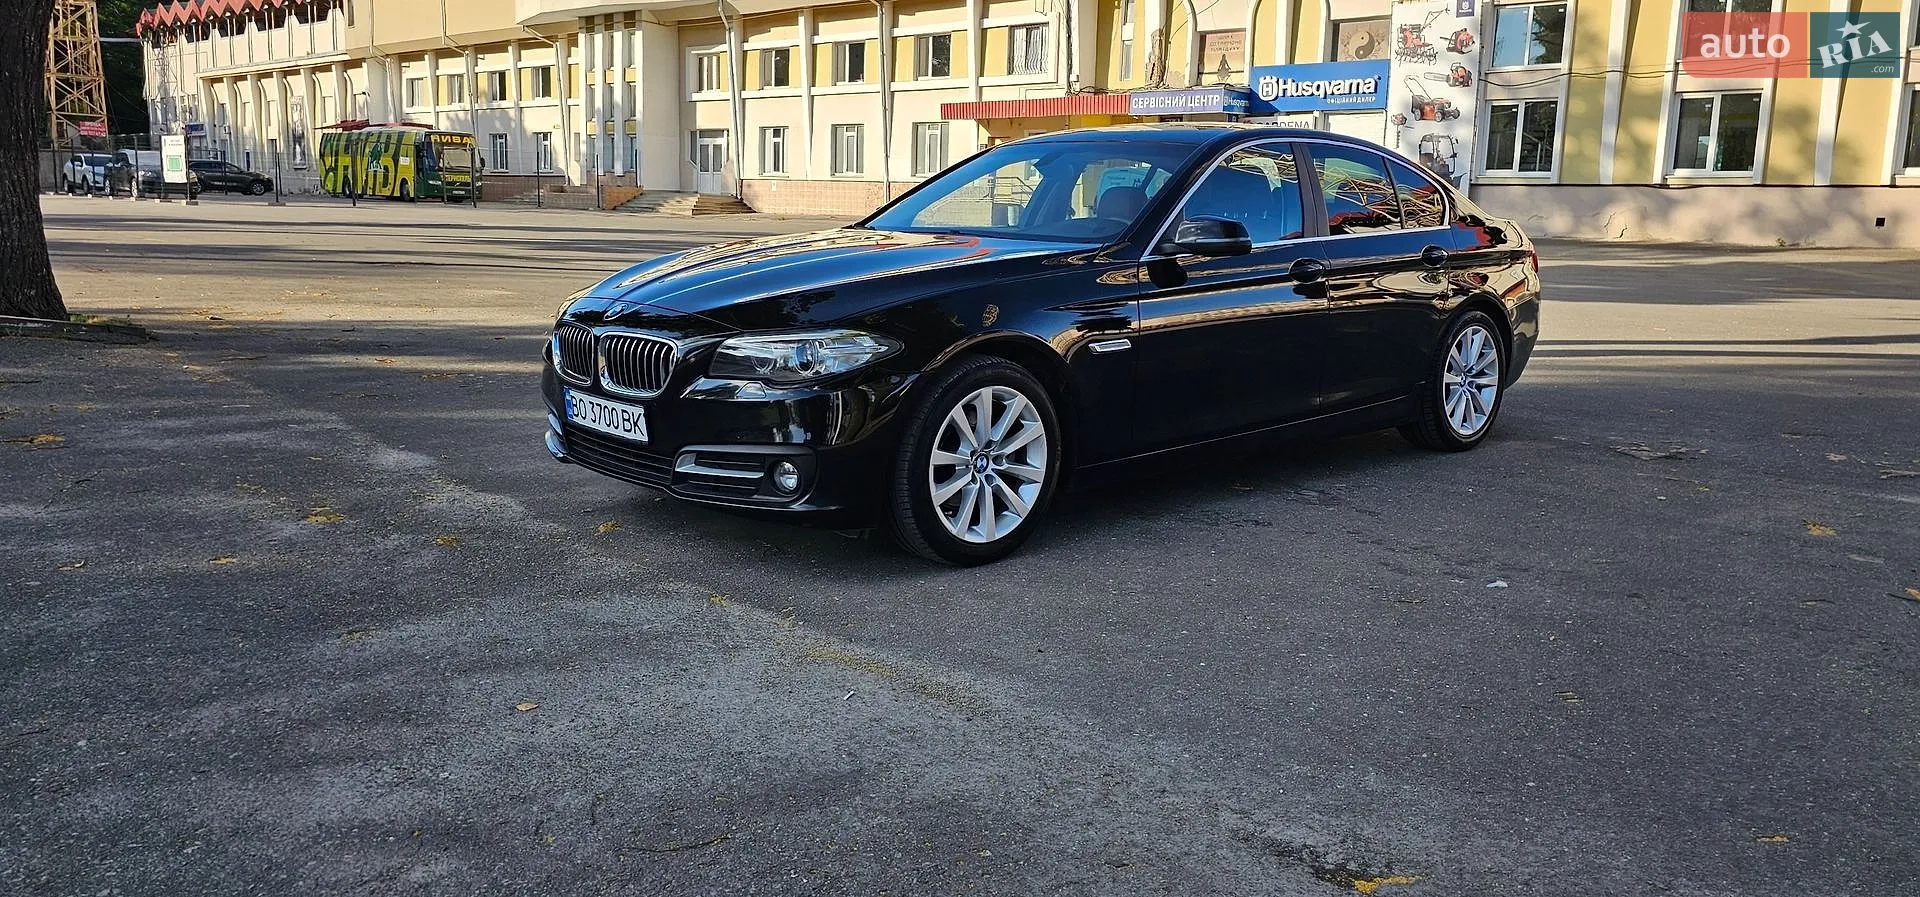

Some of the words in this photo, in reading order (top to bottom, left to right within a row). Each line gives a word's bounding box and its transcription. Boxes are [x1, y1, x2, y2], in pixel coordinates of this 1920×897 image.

[1278, 76, 1376, 99] Husqvarna
[1132, 94, 1186, 109] СЕРВІСНИЙ
[1187, 95, 1220, 109] ЦЕНТР
[430, 134, 473, 144] НИВА
[570, 394, 587, 420] BO
[588, 400, 619, 430] 3700
[621, 408, 645, 437] BK
